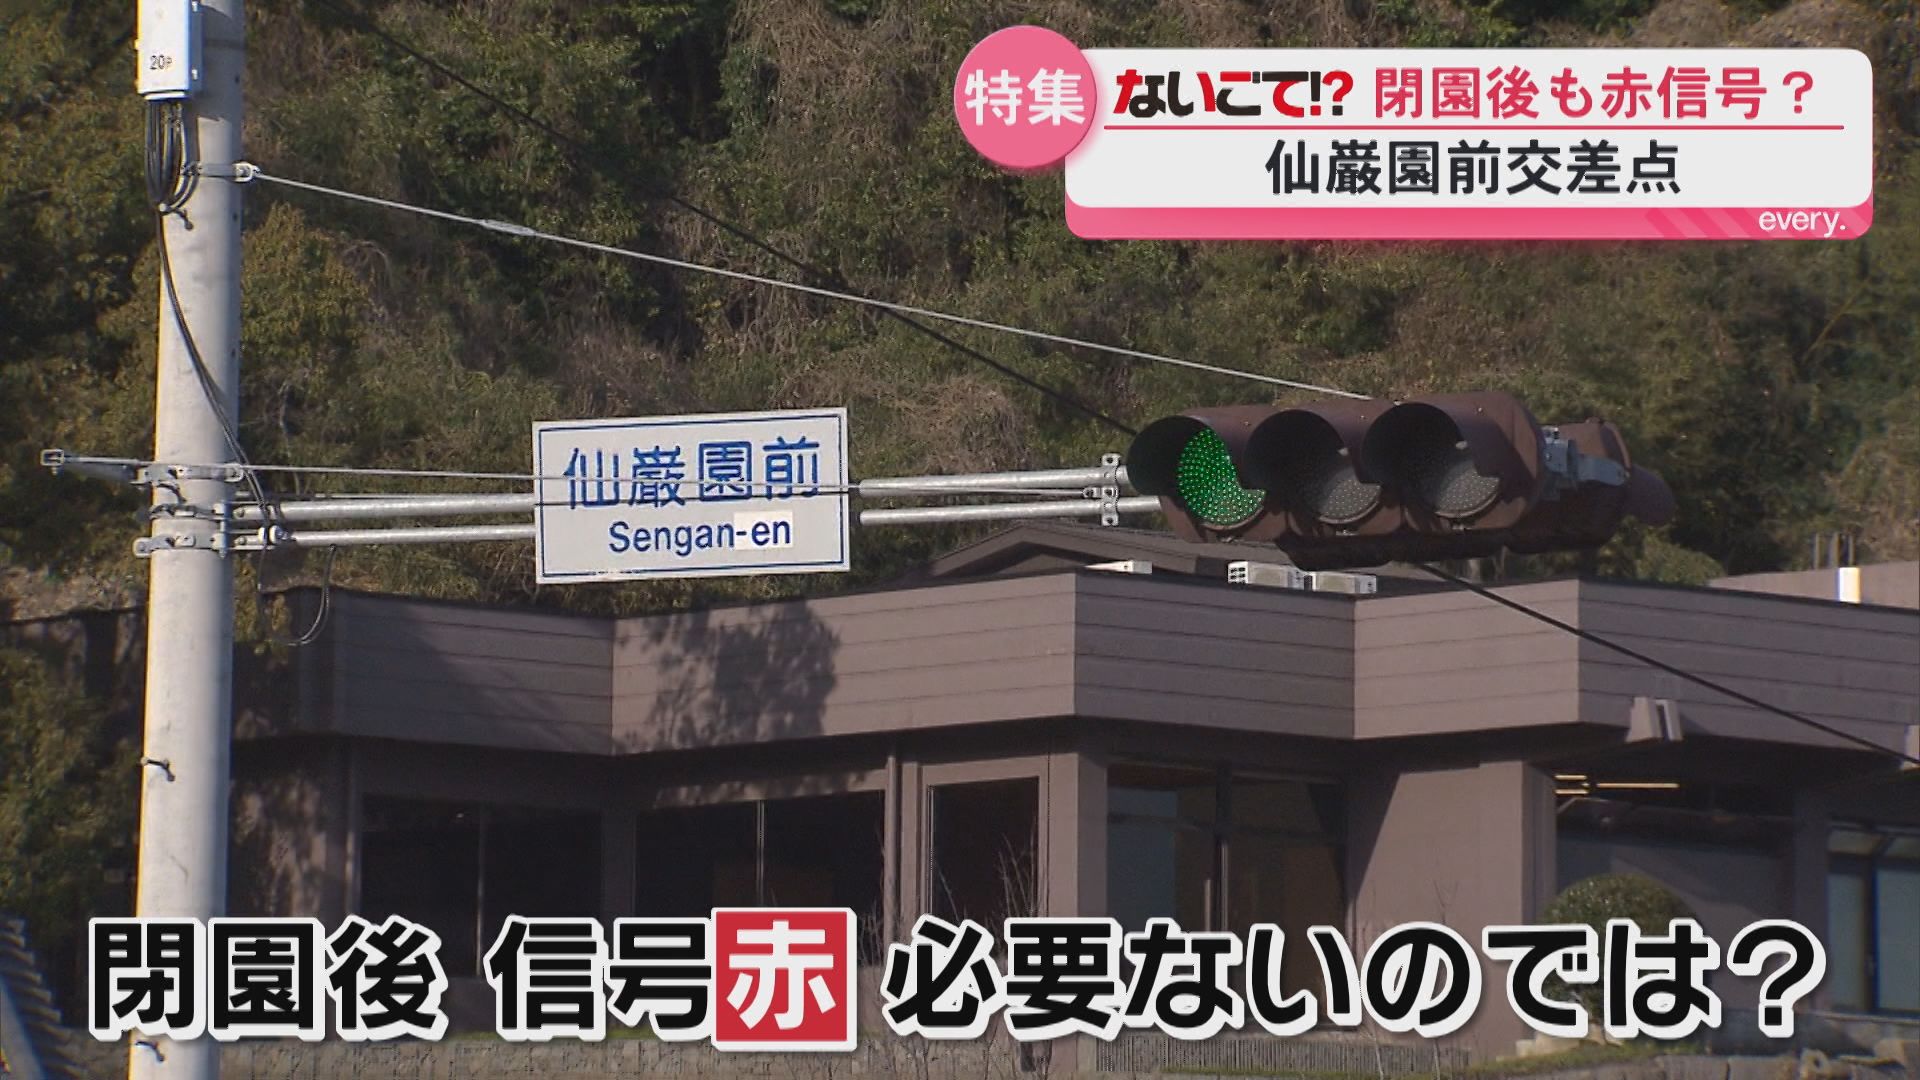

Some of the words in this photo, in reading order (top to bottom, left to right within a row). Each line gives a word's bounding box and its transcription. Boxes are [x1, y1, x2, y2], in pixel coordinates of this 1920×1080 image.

[563, 436, 820, 510] 仙巌園前
[609, 520, 792, 556] Sengan-en
